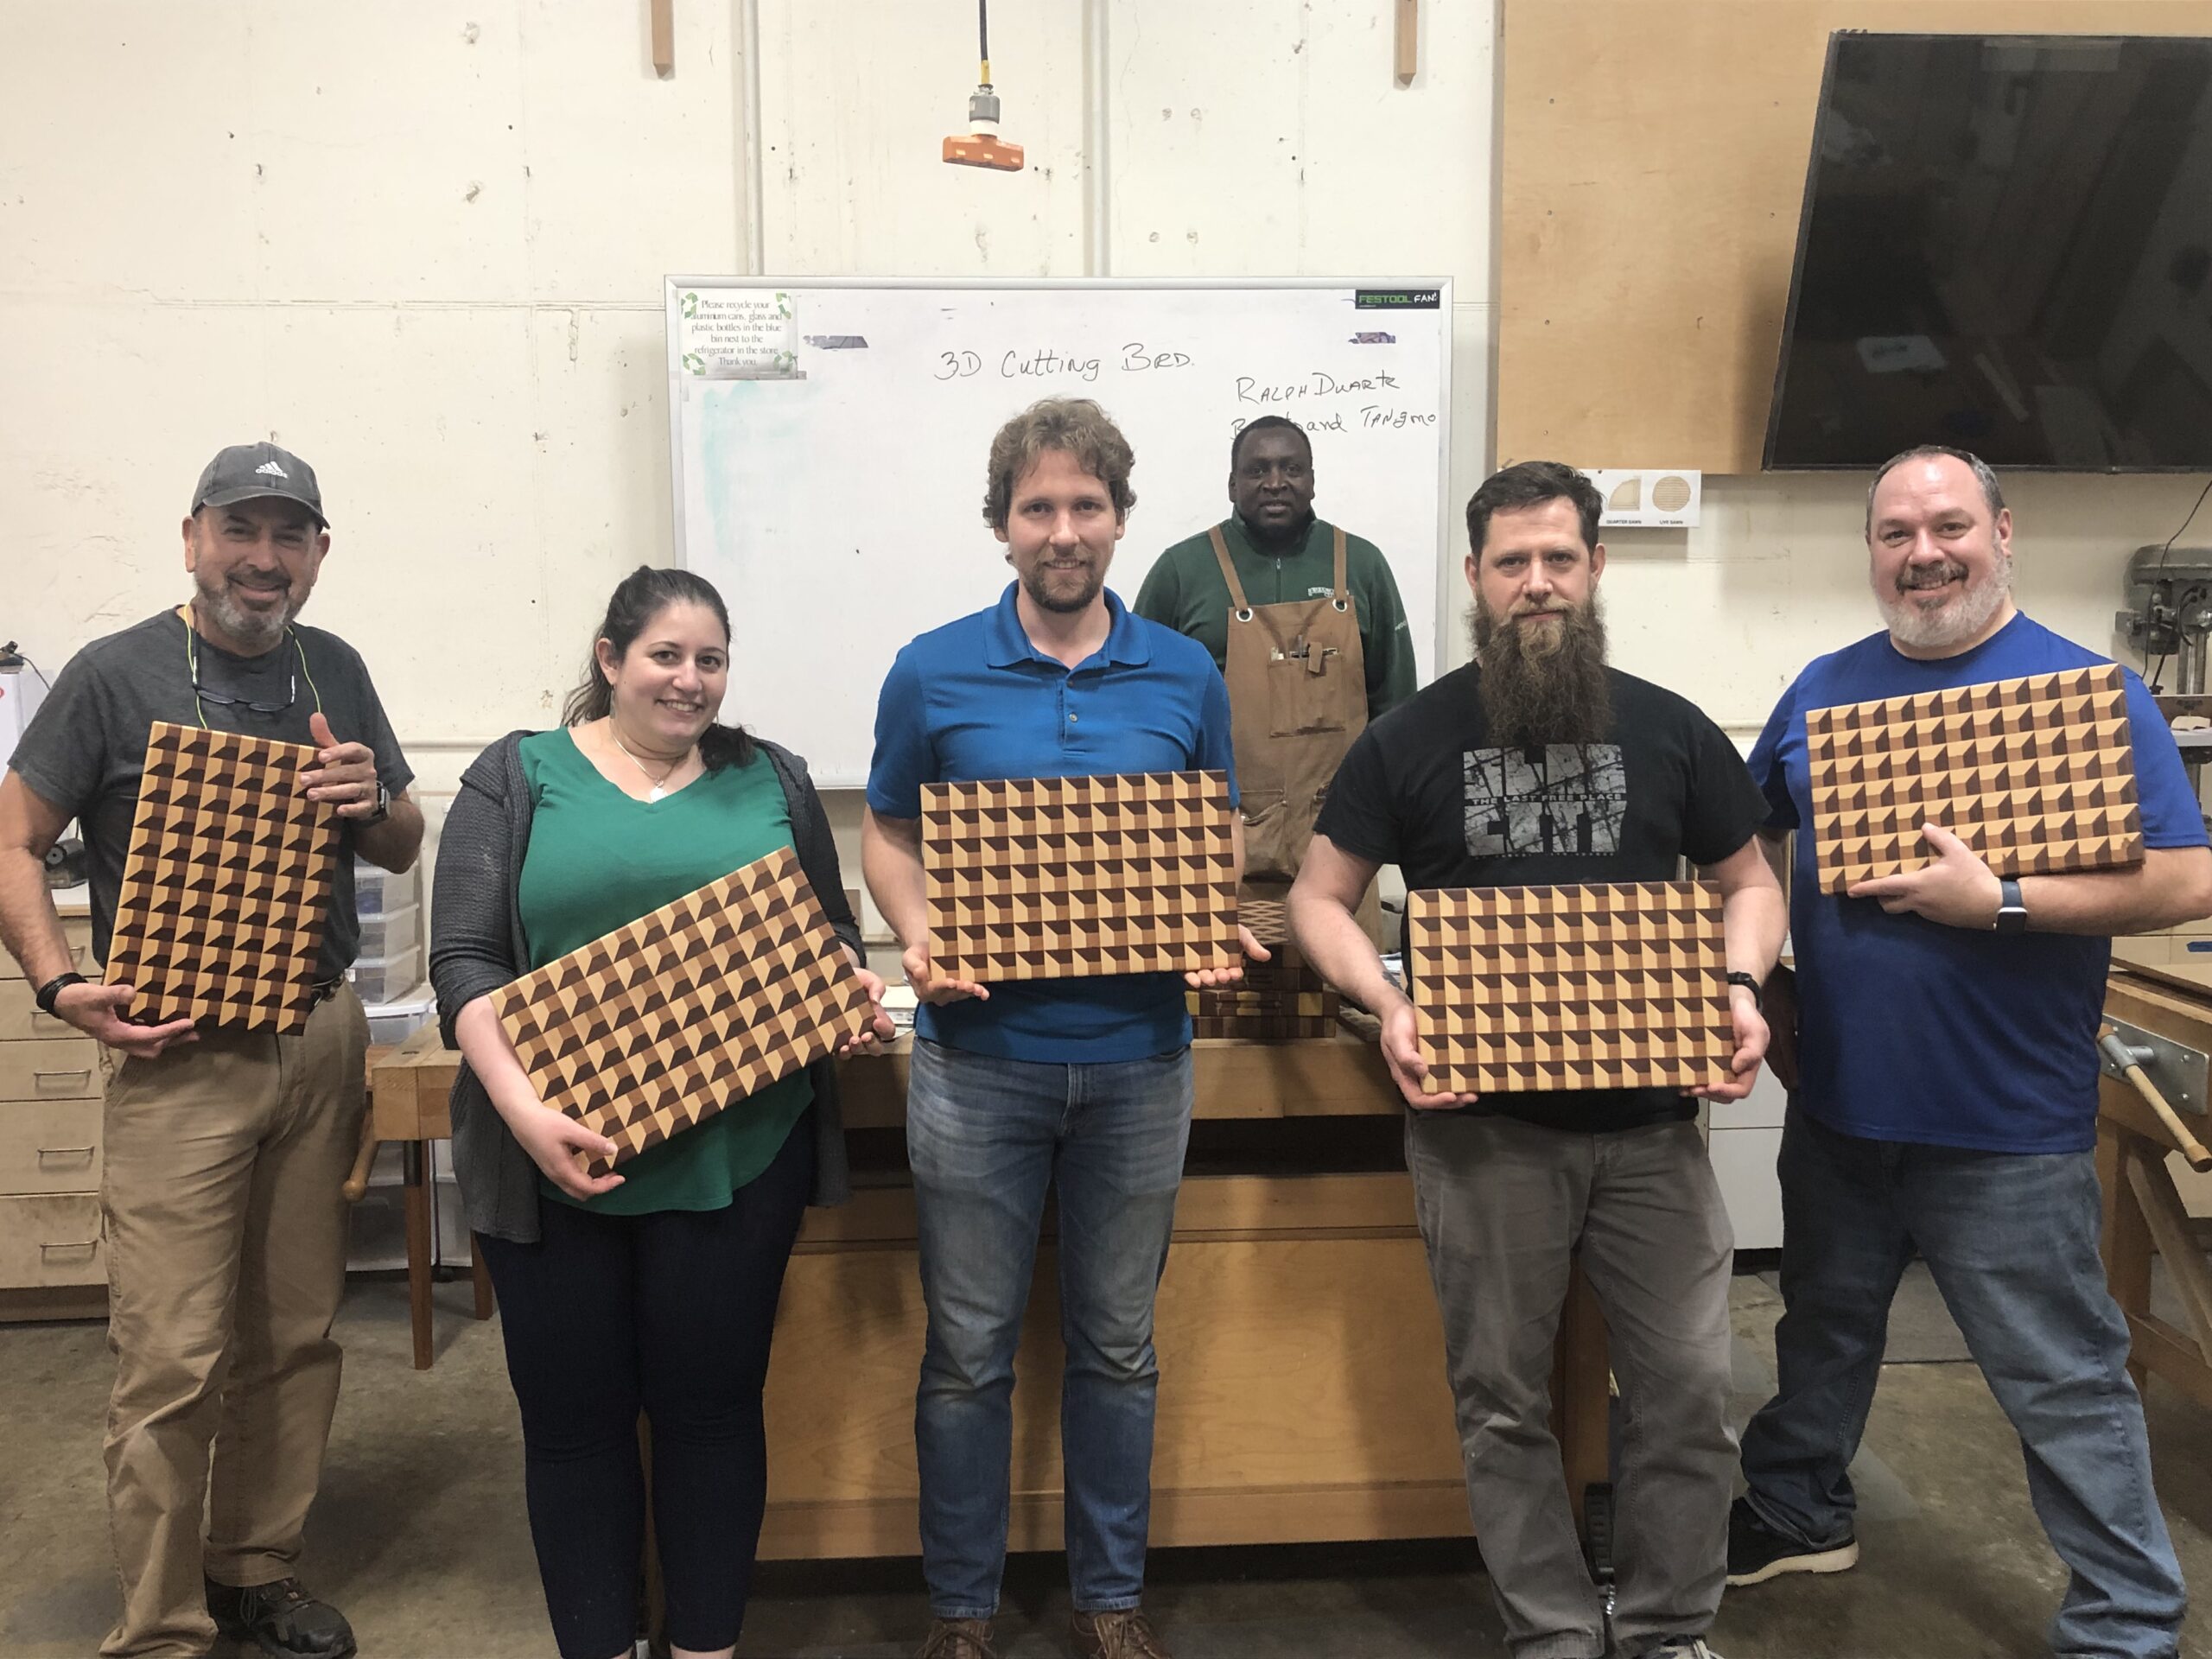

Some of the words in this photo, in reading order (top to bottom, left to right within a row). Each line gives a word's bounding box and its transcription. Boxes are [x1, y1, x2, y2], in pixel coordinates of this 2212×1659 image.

[1359, 295, 1412, 303] FESTOOL
[702, 300, 724, 309] Please
[727, 300, 752, 312] recycle
[753, 302, 769, 312] your
[691, 312, 727, 321] aluminum
[748, 312, 766, 322] glass
[767, 312, 782, 321] and
[692, 323, 715, 334] plastic
[716, 323, 741, 332] bottles
[743, 323, 750, 332] in
[752, 323, 764, 332] the
[766, 323, 781, 332] blue
[711, 334, 722, 343] bin
[752, 334, 763, 343] the
[695, 346, 735, 357] refrigerator
[737, 346, 745, 354] in
[747, 346, 759, 354] the
[719, 357, 741, 365] Thank
[934, 351, 982, 380] 3D
[1001, 349, 1101, 381] Cutting
[1236, 377, 1307, 404] RALPH
[255, 468, 288, 479] adidas
